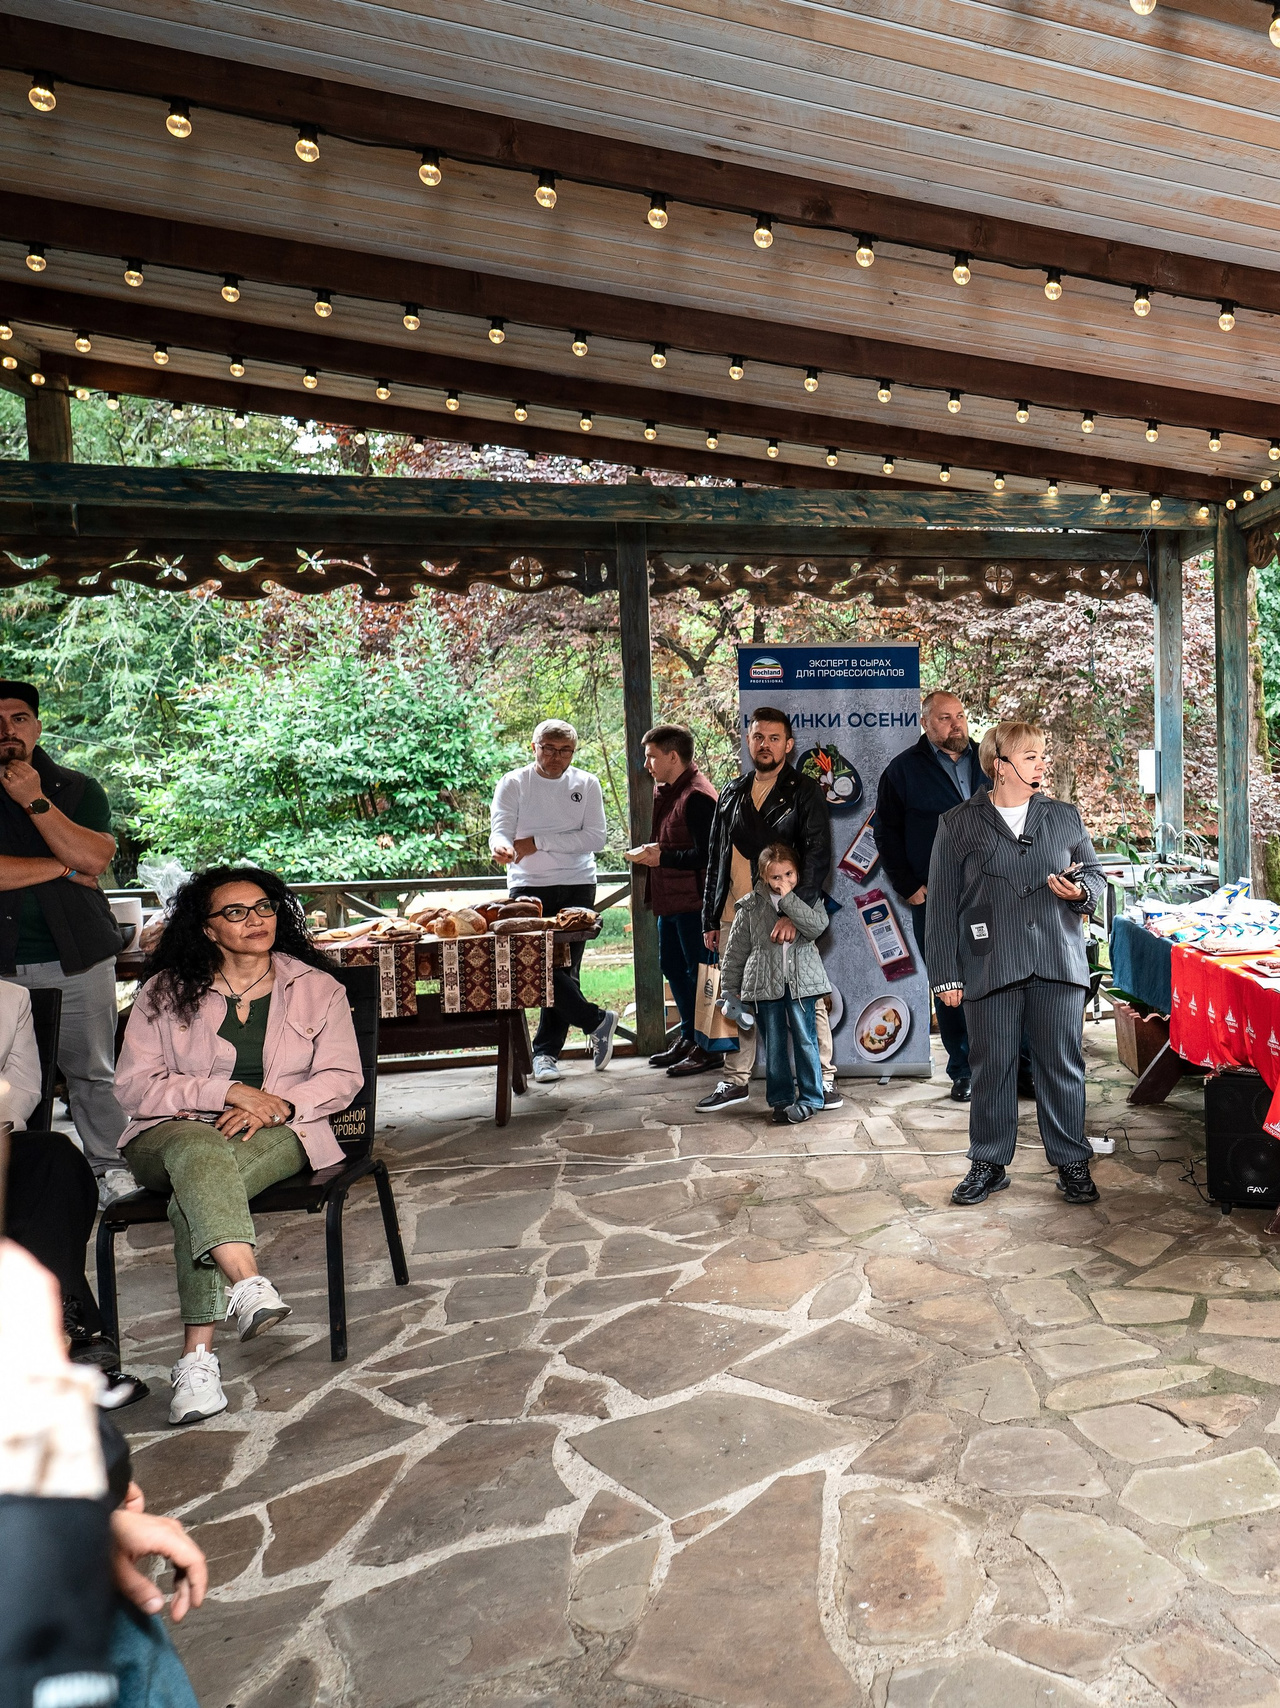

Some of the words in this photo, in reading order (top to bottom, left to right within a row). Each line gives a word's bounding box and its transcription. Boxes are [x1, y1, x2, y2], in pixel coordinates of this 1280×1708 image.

[809, 659, 849, 668] ЭКСПЕРТ
[851, 659, 858, 667] В
[860, 659, 892, 667] СЫРАХ
[796, 669, 816, 678] ДЛЯ
[818, 668, 905, 677] ПРОФЕССИОНАЛОВ
[744, 713, 841, 728] НИНКИ
[847, 712, 918, 728] ОСЕНИ
[331, 1122, 366, 1136] ОРОВЬЮ
